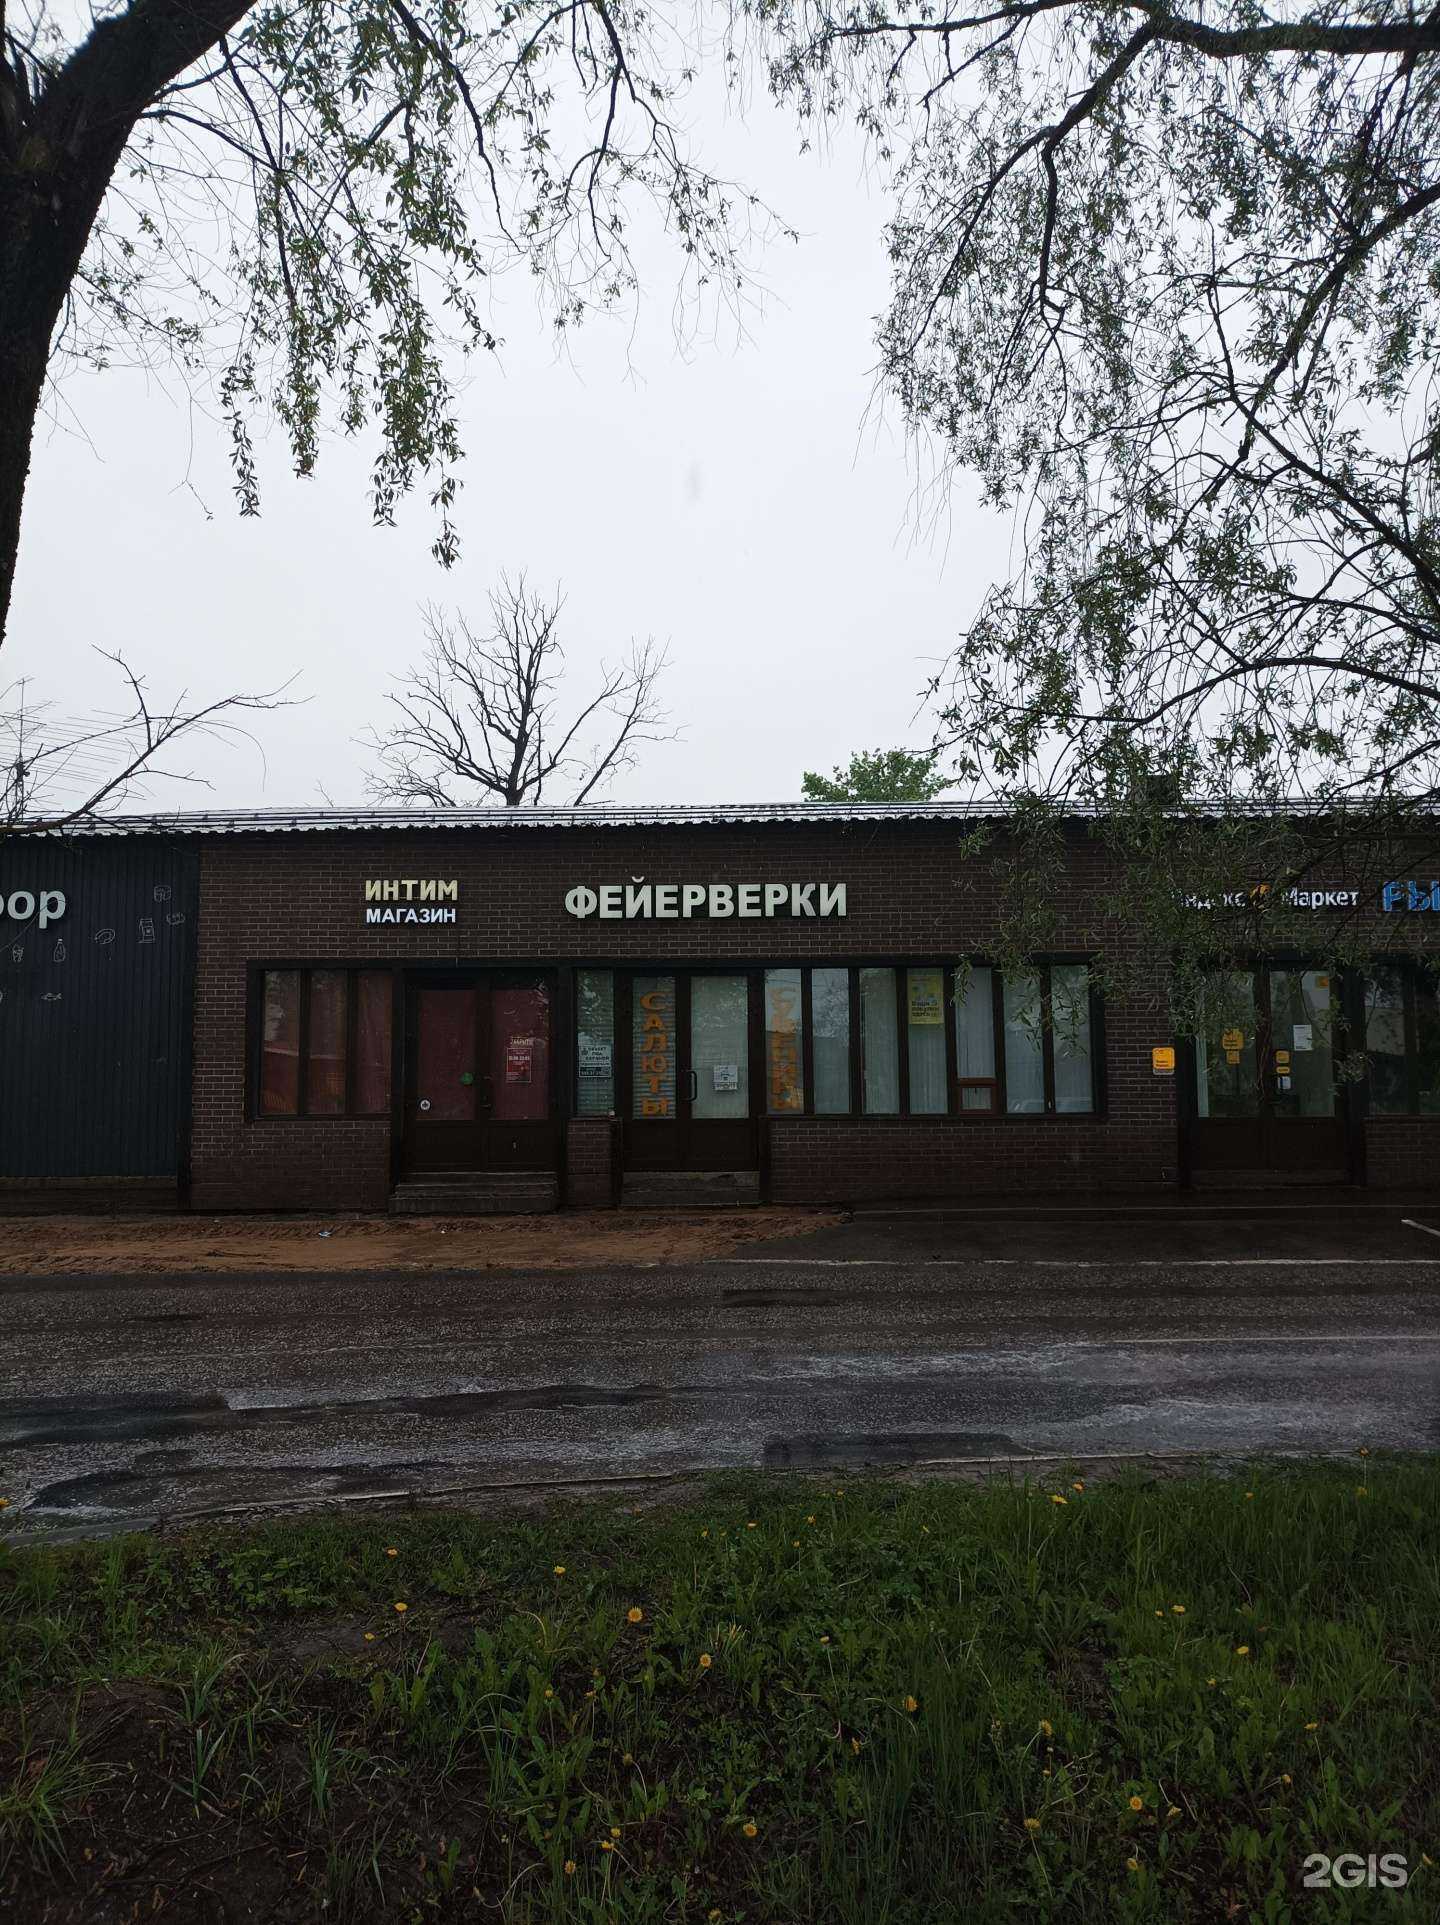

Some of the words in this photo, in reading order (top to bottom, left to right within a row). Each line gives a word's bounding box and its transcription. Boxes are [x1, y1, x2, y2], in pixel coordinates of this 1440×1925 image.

[365, 880, 458, 901] ИНТИМ
[564, 876, 847, 919] ФЕЙЕРВЕРКИ
[0, 890, 66, 929] ор
[366, 908, 456, 923] МАГАЗИН
